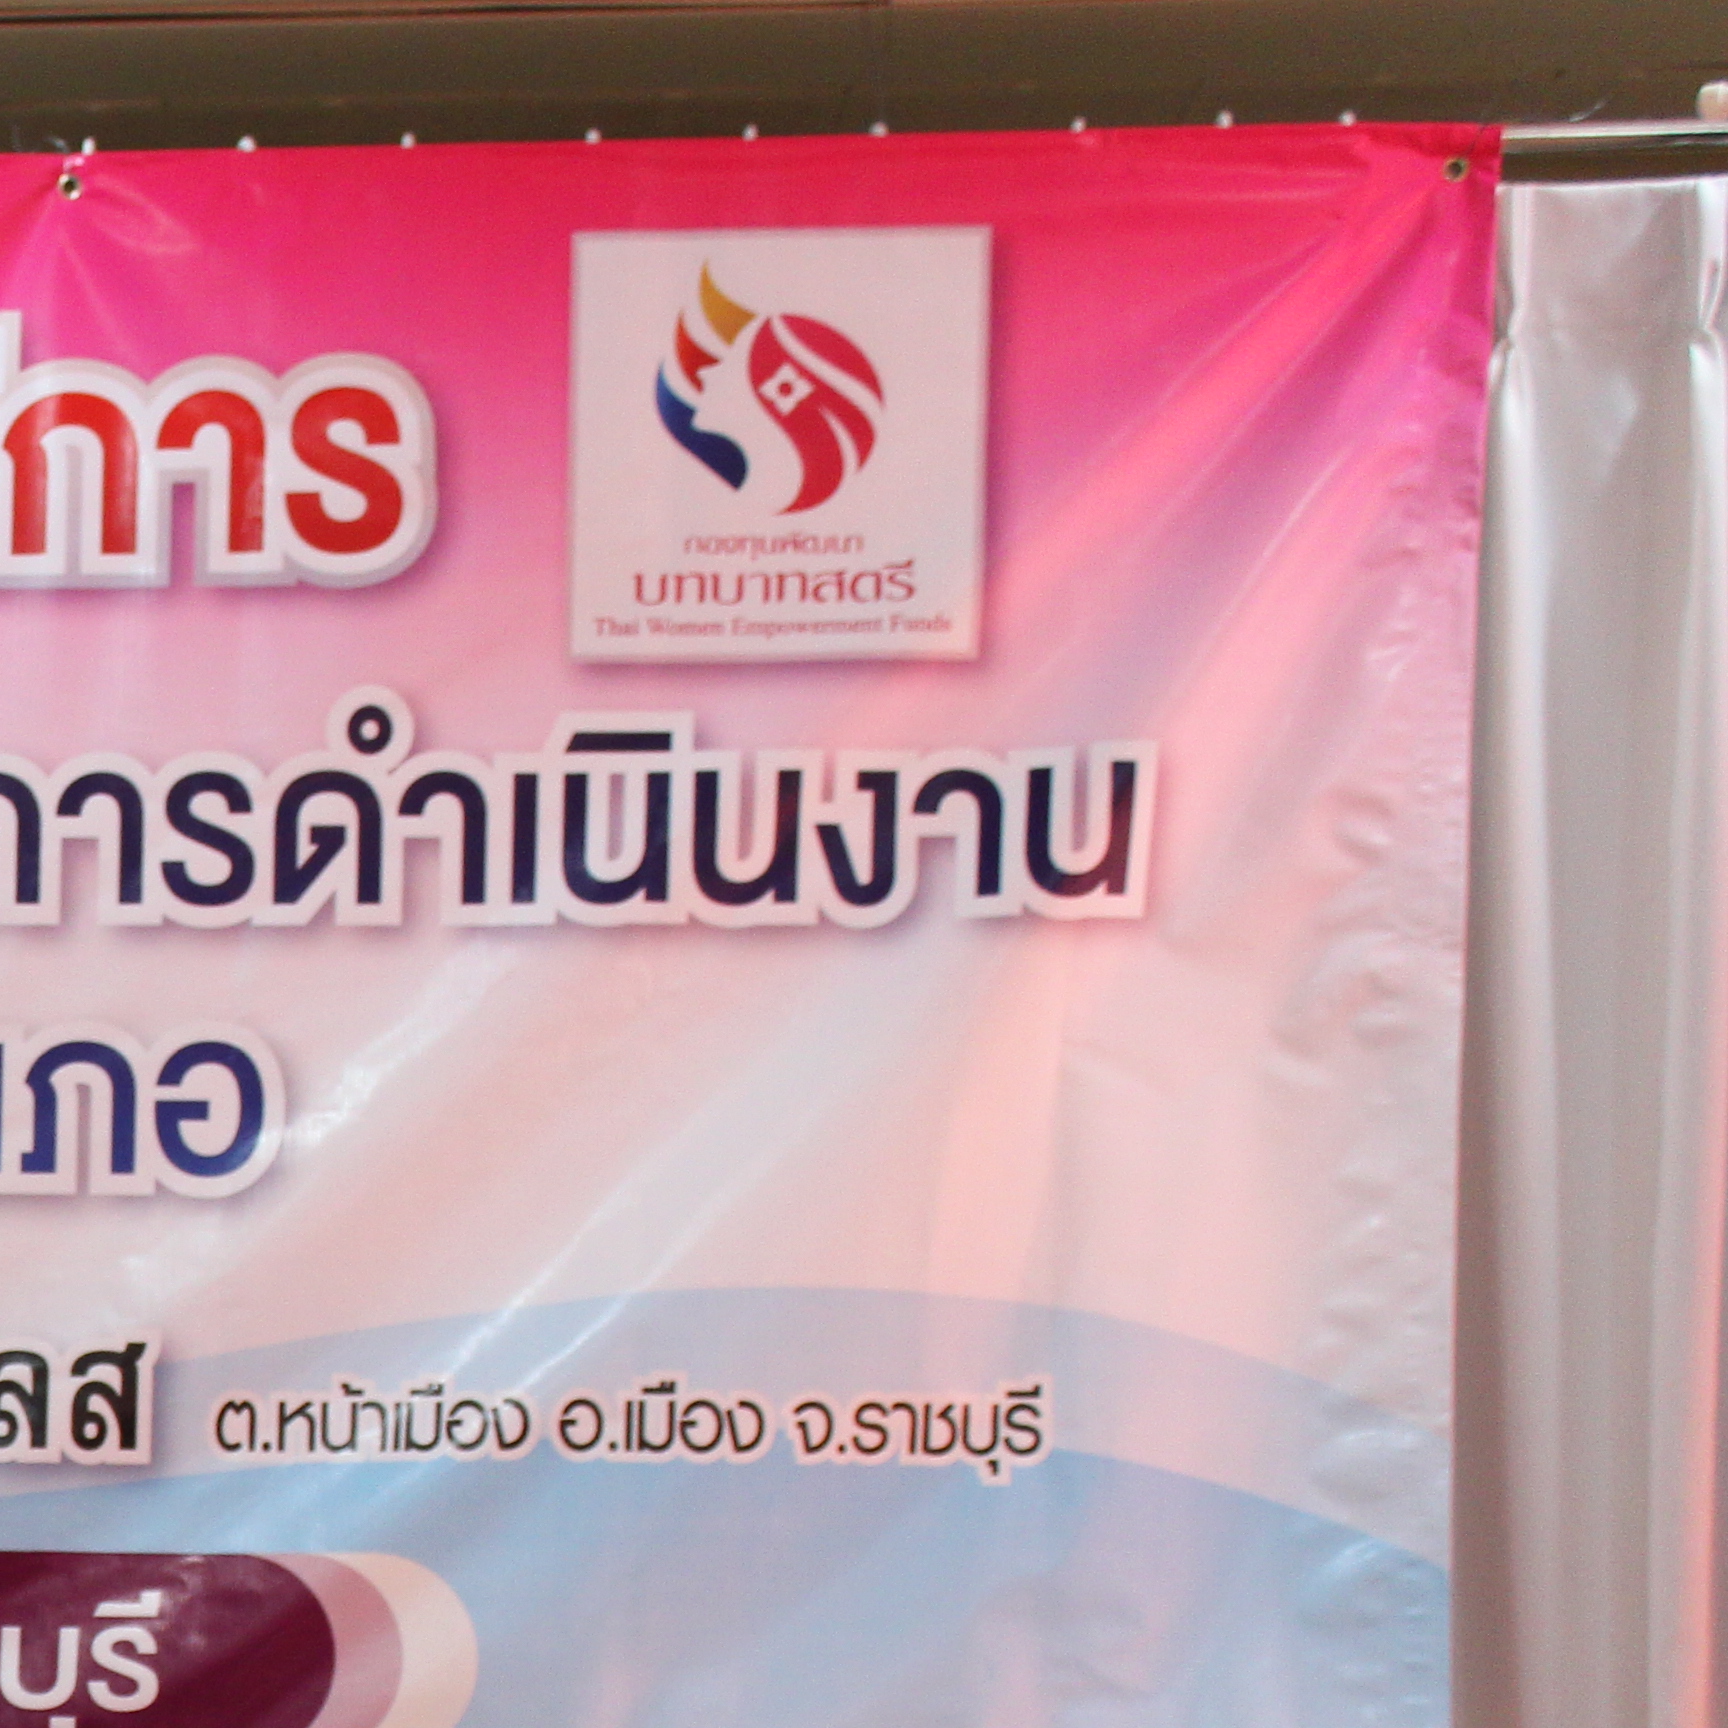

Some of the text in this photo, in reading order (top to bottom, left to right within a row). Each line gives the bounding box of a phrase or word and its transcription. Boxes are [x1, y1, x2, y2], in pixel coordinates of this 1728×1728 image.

[632, 558, 917, 606] บทบาทสตรี
[215, 1382, 531, 1454] ต.หน้าเมือง
[559, 1380, 766, 1453] อ.เมือง
[793, 1384, 1044, 1476] จ.ราชบุรี
